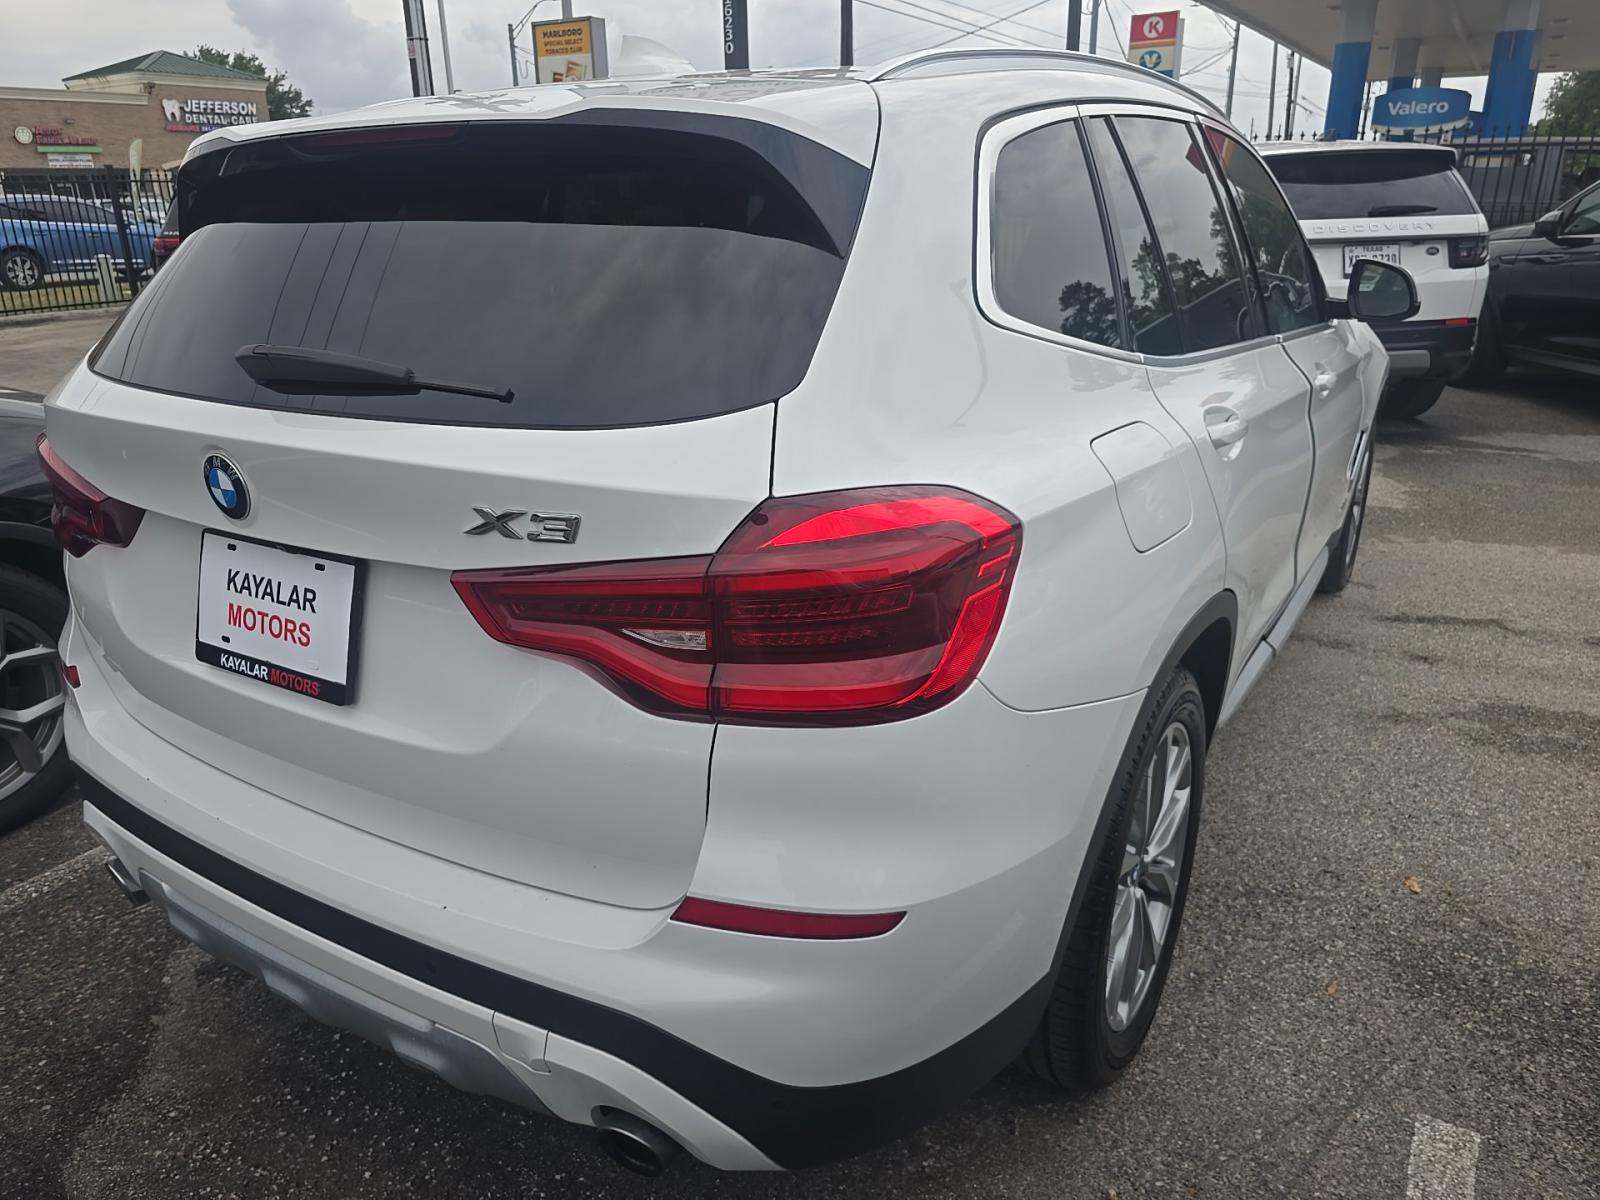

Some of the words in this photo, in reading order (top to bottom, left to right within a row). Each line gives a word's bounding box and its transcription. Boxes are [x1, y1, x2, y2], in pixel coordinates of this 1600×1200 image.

[183, 99, 257, 115] JEFFERSON
[185, 114, 227, 125] DENTAL
[1388, 101, 1449, 116] Valero
[1312, 222, 1435, 234] DISCOVERY
[464, 506, 582, 544] X3
[227, 568, 317, 613] KAYALAR
[228, 602, 312, 648] MOTORS
[220, 653, 268, 681] KAYALAR
[270, 668, 320, 697] MOTORS
